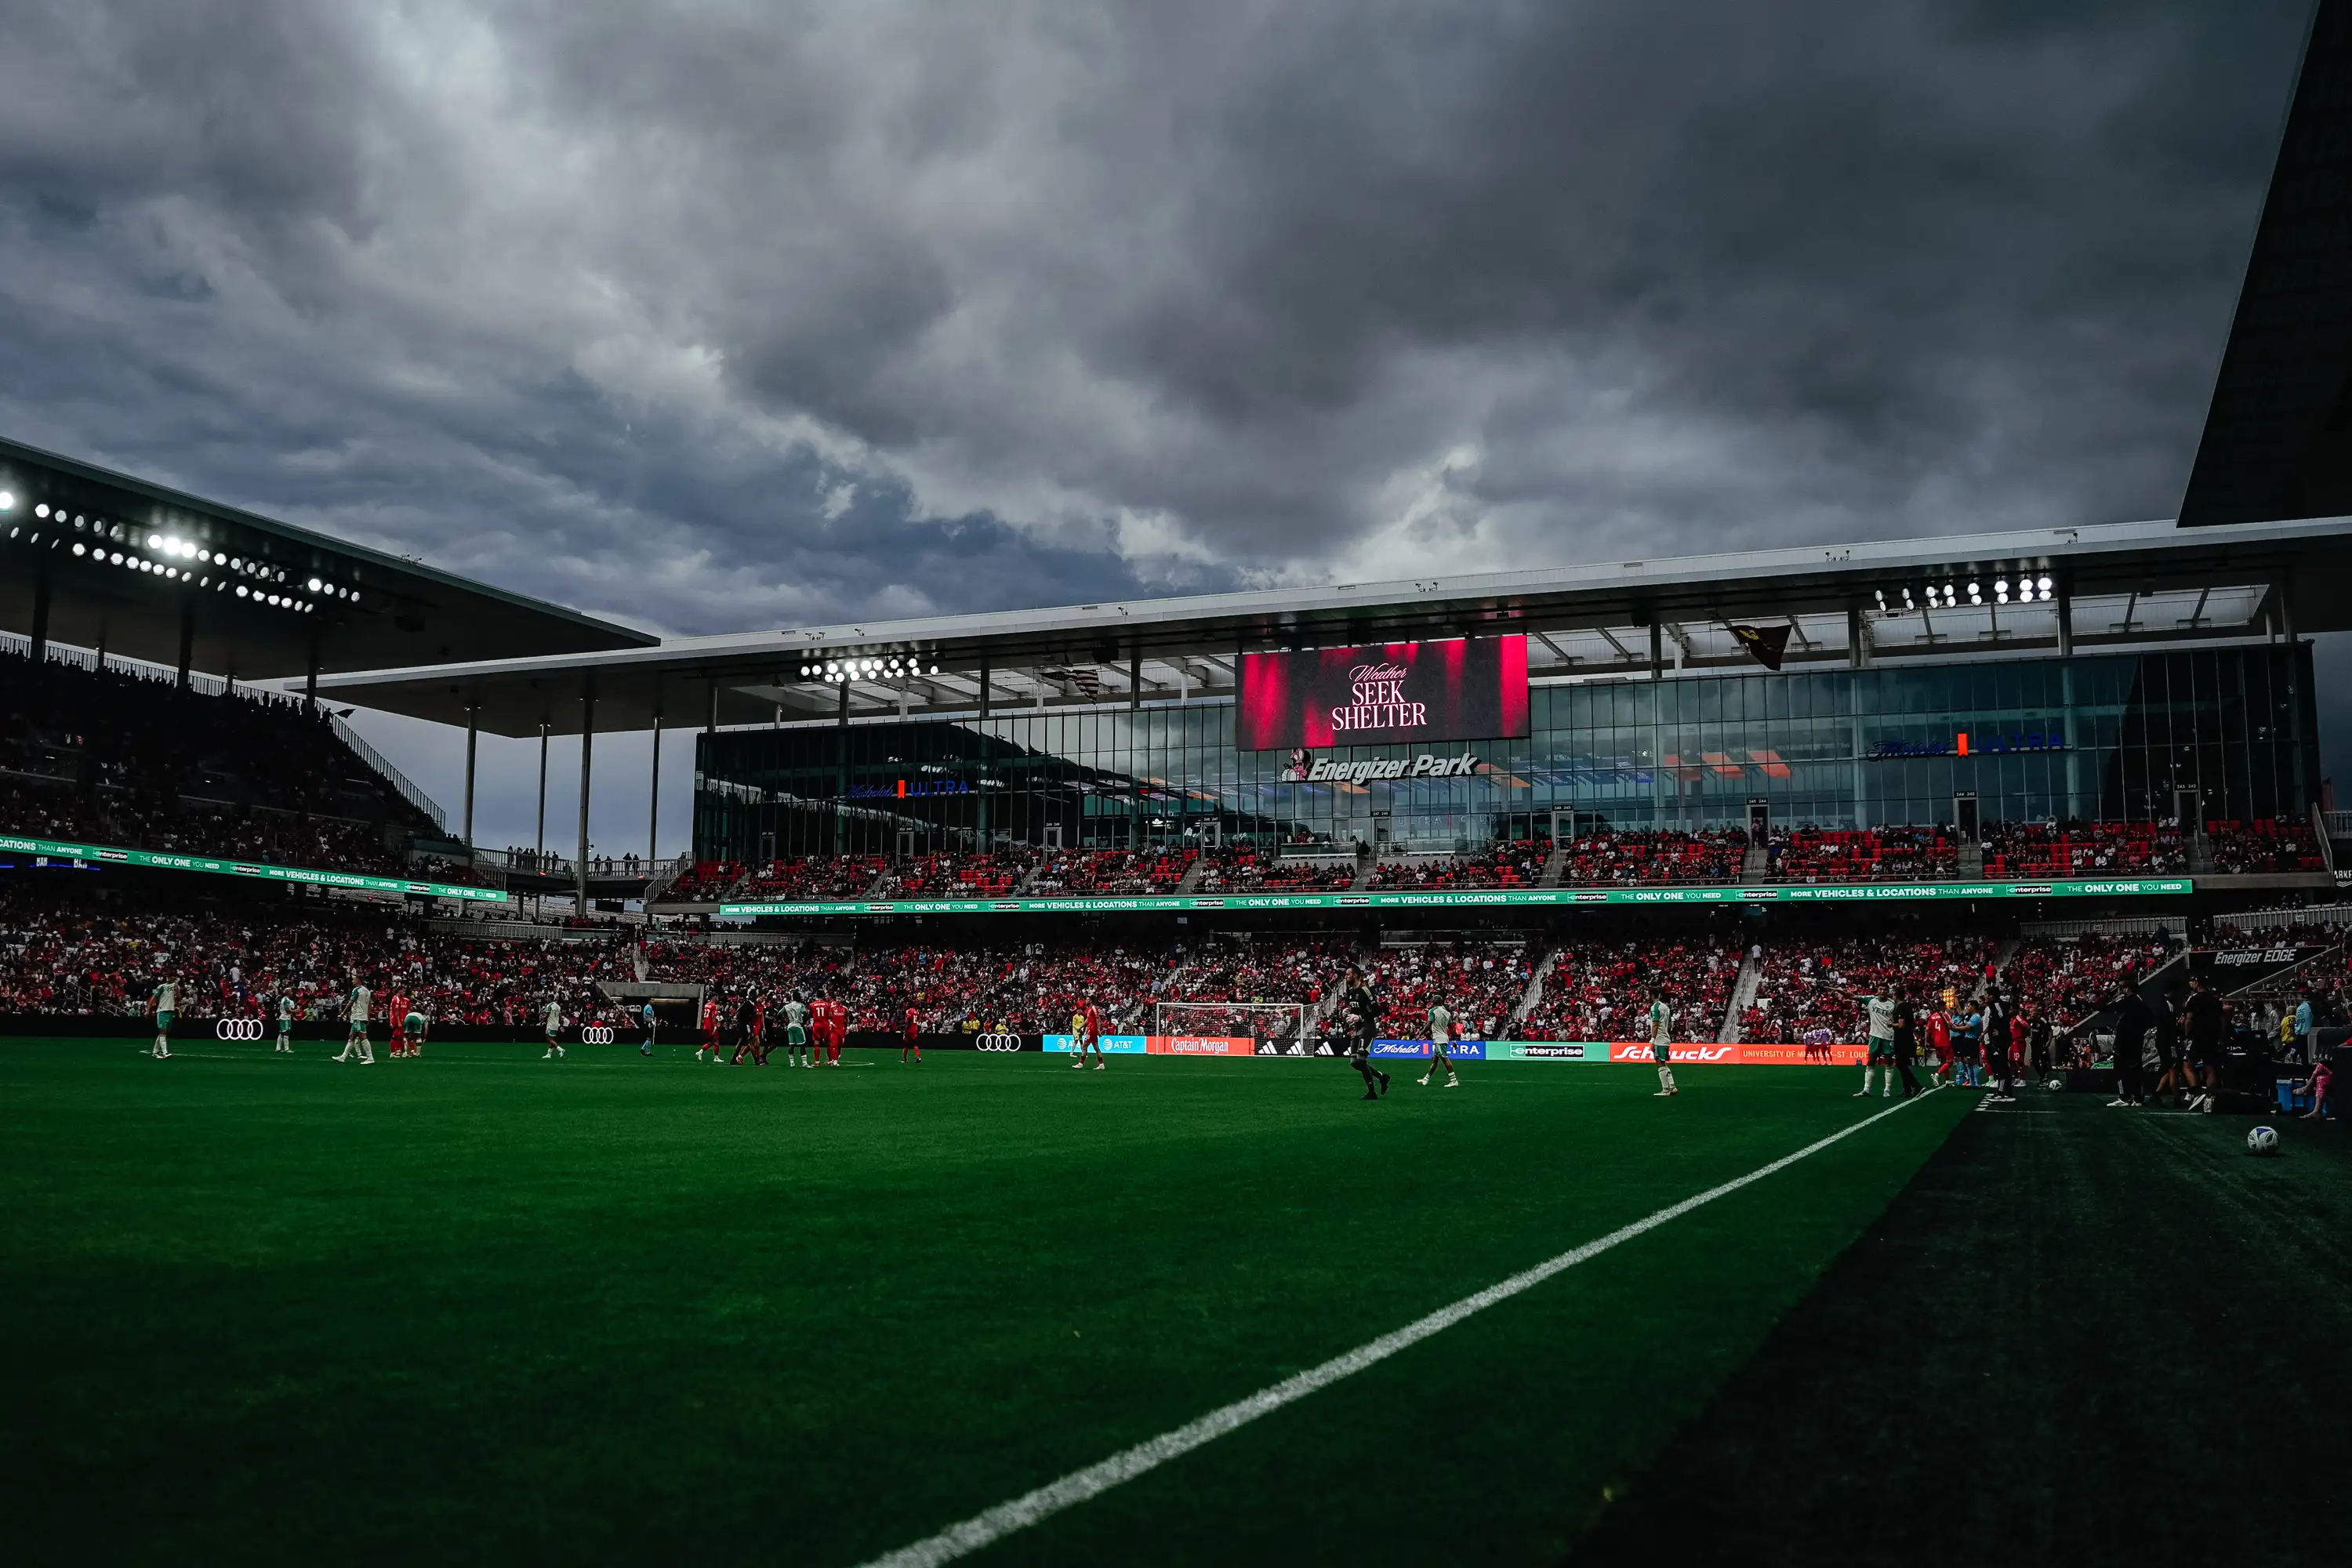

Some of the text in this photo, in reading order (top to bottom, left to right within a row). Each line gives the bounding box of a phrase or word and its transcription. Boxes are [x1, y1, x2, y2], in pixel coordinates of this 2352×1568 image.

[1349, 663, 1407, 682] Weather
[1352, 681, 1405, 706] SEEK
[1332, 702, 1427, 730] SHELTER
[1976, 734, 2063, 753] ULTRA
[1308, 753, 1477, 785] Energizer Park
[846, 780, 969, 798] Michelob ULTRA
[56, 847, 83, 855] ANYONE
[93, 849, 127, 860] enterprise
[140, 855, 151, 863] THE
[151, 855, 173, 866] ONLY
[174, 858, 191, 867] ONE
[192, 859, 205, 868] YOU
[230, 864, 261, 874] enterprise
[269, 869, 285, 877] MORE
[285, 870, 320, 882] VEHICLES
[326, 875, 365, 886] LOCATIONS
[405, 884, 430, 892] enterprise
[447, 887, 463, 896] ONLY
[463, 888, 476, 897] ONE
[1814, 889, 1865, 898] VEHICLES
[1866, 888, 1875, 897] &
[1876, 887, 1936, 897] LOCATIONS
[2007, 885, 2052, 894] enterprise
[2085, 884, 2114, 893] ONLY
[2115, 883, 2140, 891] ONE
[1401, 895, 1445, 904] VEHICLES
[1454, 895, 1507, 903] LOCATIONS
[1635, 892, 1662, 901] ONLY
[1663, 891, 1684, 900] ONE
[2214, 949, 2297, 967] Energizer EDGE
[816, 1007, 825, 1017] 11
[1872, 1007, 1889, 1016] YETI
[1934, 1020, 1941, 1032] 4
[1113, 1040, 1132, 1049] AT&T
[1171, 1037, 1229, 1054] Captain Morgan
[1374, 1044, 1421, 1054] Michelob
[1512, 1044, 1583, 1056] enterprise
[1613, 1046, 1732, 1060] Schucks
